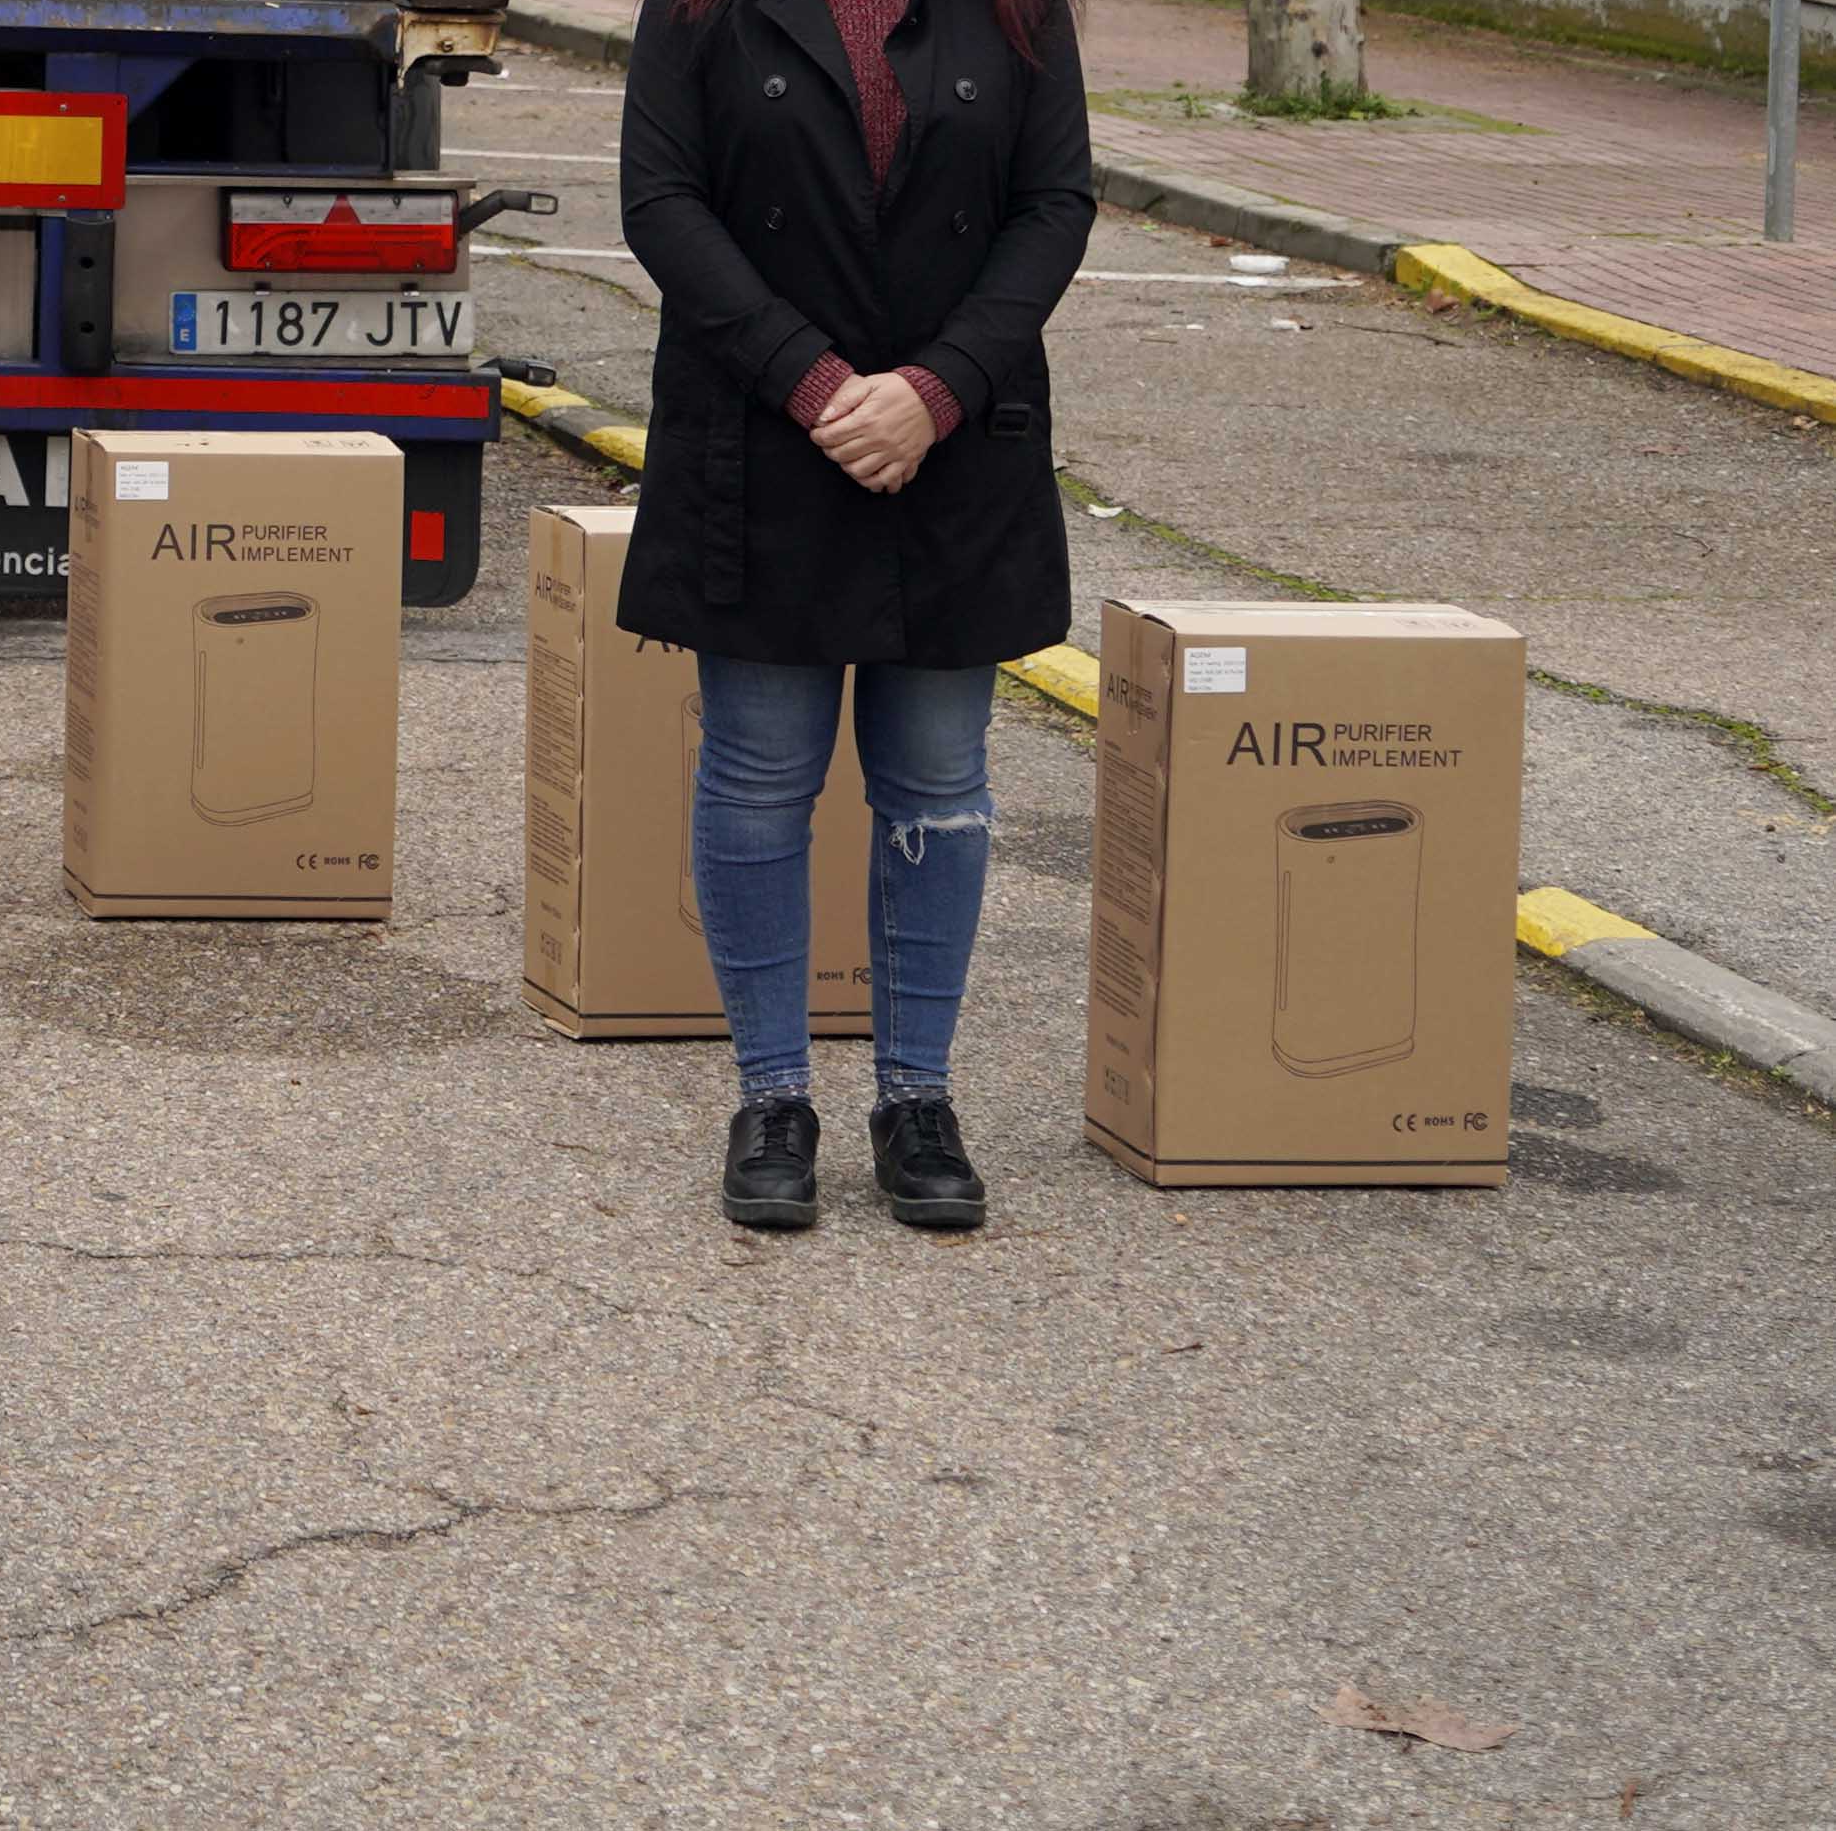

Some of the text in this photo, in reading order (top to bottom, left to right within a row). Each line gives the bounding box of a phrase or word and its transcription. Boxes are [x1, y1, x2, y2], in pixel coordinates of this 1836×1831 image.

[216, 301, 339, 346] 1187
[366, 301, 462, 347] JTV
[151, 524, 327, 561] AIR PURIFIER
[241, 546, 354, 562] IMPLEMENT
[1226, 722, 1432, 766] AIR PURIFIER
[1332, 749, 1462, 767] IMPLEMENT
[324, 856, 350, 865] ROHS
[1424, 1117, 1454, 1126] ROHS
